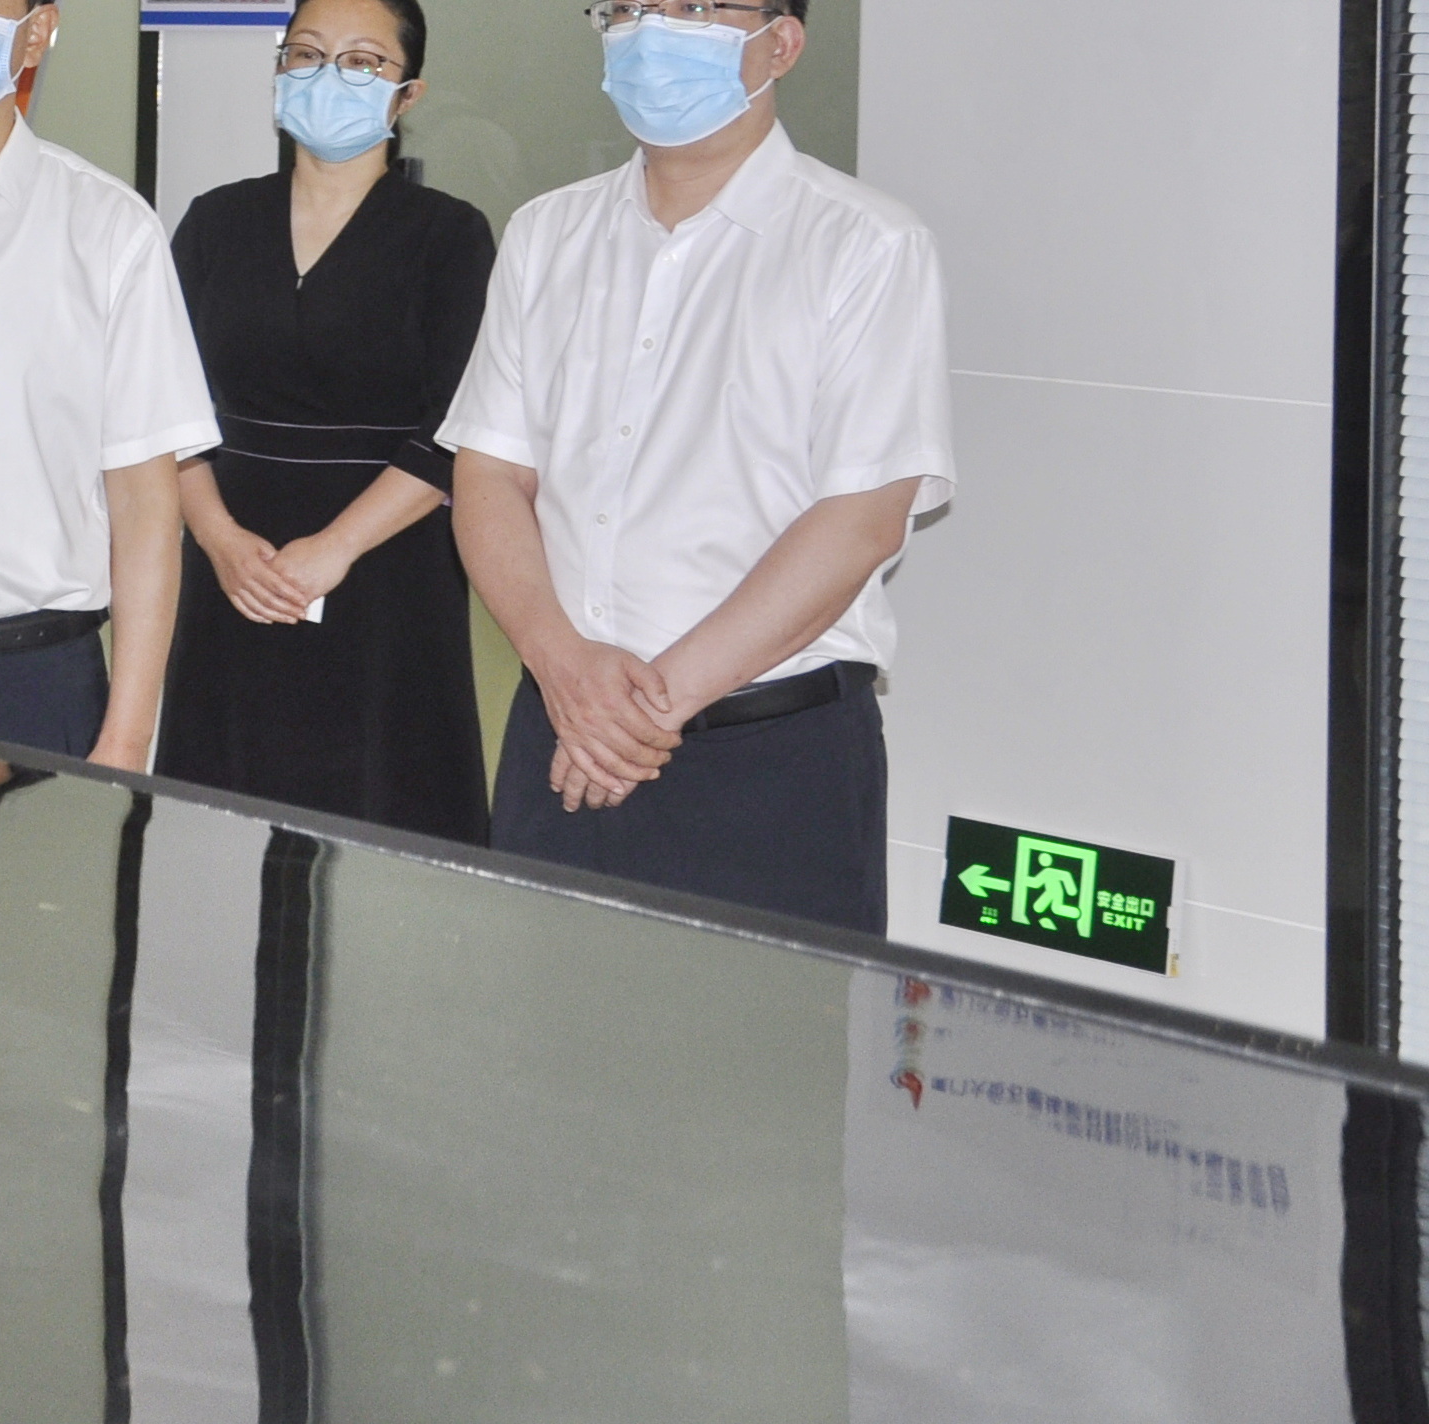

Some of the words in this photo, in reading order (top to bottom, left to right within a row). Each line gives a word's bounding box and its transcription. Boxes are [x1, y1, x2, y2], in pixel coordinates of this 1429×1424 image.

[1097, 890, 1155, 917] 安全出口
[1102, 912, 1146, 930] EXIT
